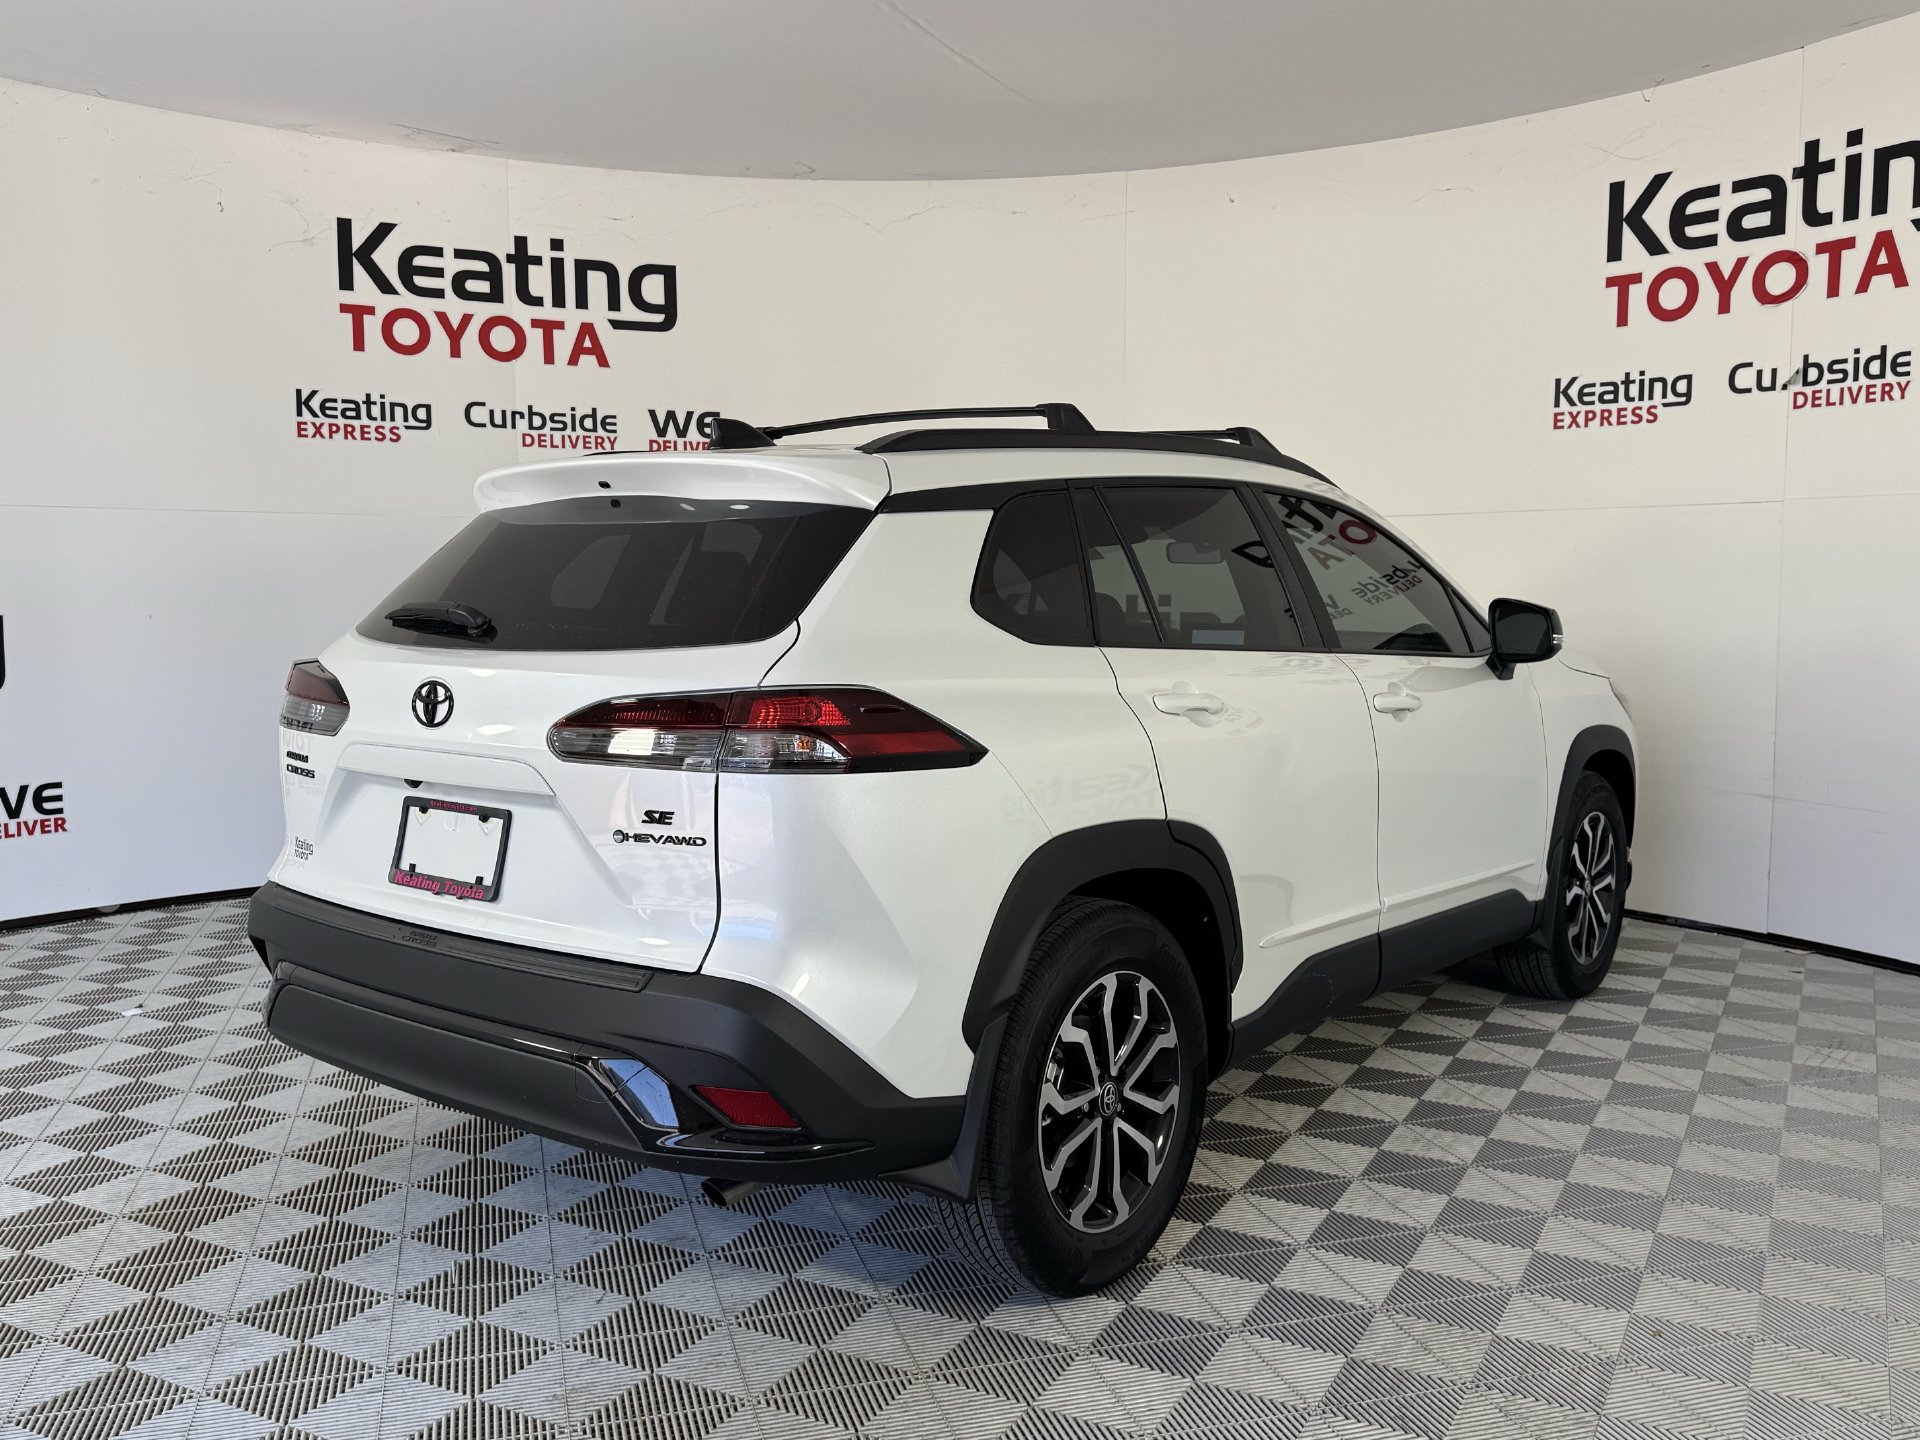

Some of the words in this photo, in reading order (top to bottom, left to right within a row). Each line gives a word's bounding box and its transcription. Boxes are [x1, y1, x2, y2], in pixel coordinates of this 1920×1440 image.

[1606, 127, 1920, 263] Keatin
[337, 217, 677, 332] Keating
[1605, 229, 1909, 327] TOYOTA
[340, 303, 610, 368] TOYOTA
[1728, 345, 1911, 395] Cubside
[1553, 371, 1692, 408] Keating
[1792, 381, 1910, 410] DELIVERY
[295, 389, 431, 430] Keating
[465, 402, 617, 434] Curbside
[1553, 405, 1659, 430] EXPRESS
[296, 421, 401, 443] EXPRESS
[522, 432, 617, 451] DELIVERY
[648, 439, 710, 452] DELIVE
[0, 817, 68, 839] LIVER
[641, 809, 675, 825] SE
[395, 870, 440, 893] Keating
[444, 881, 485, 900] Toyota
